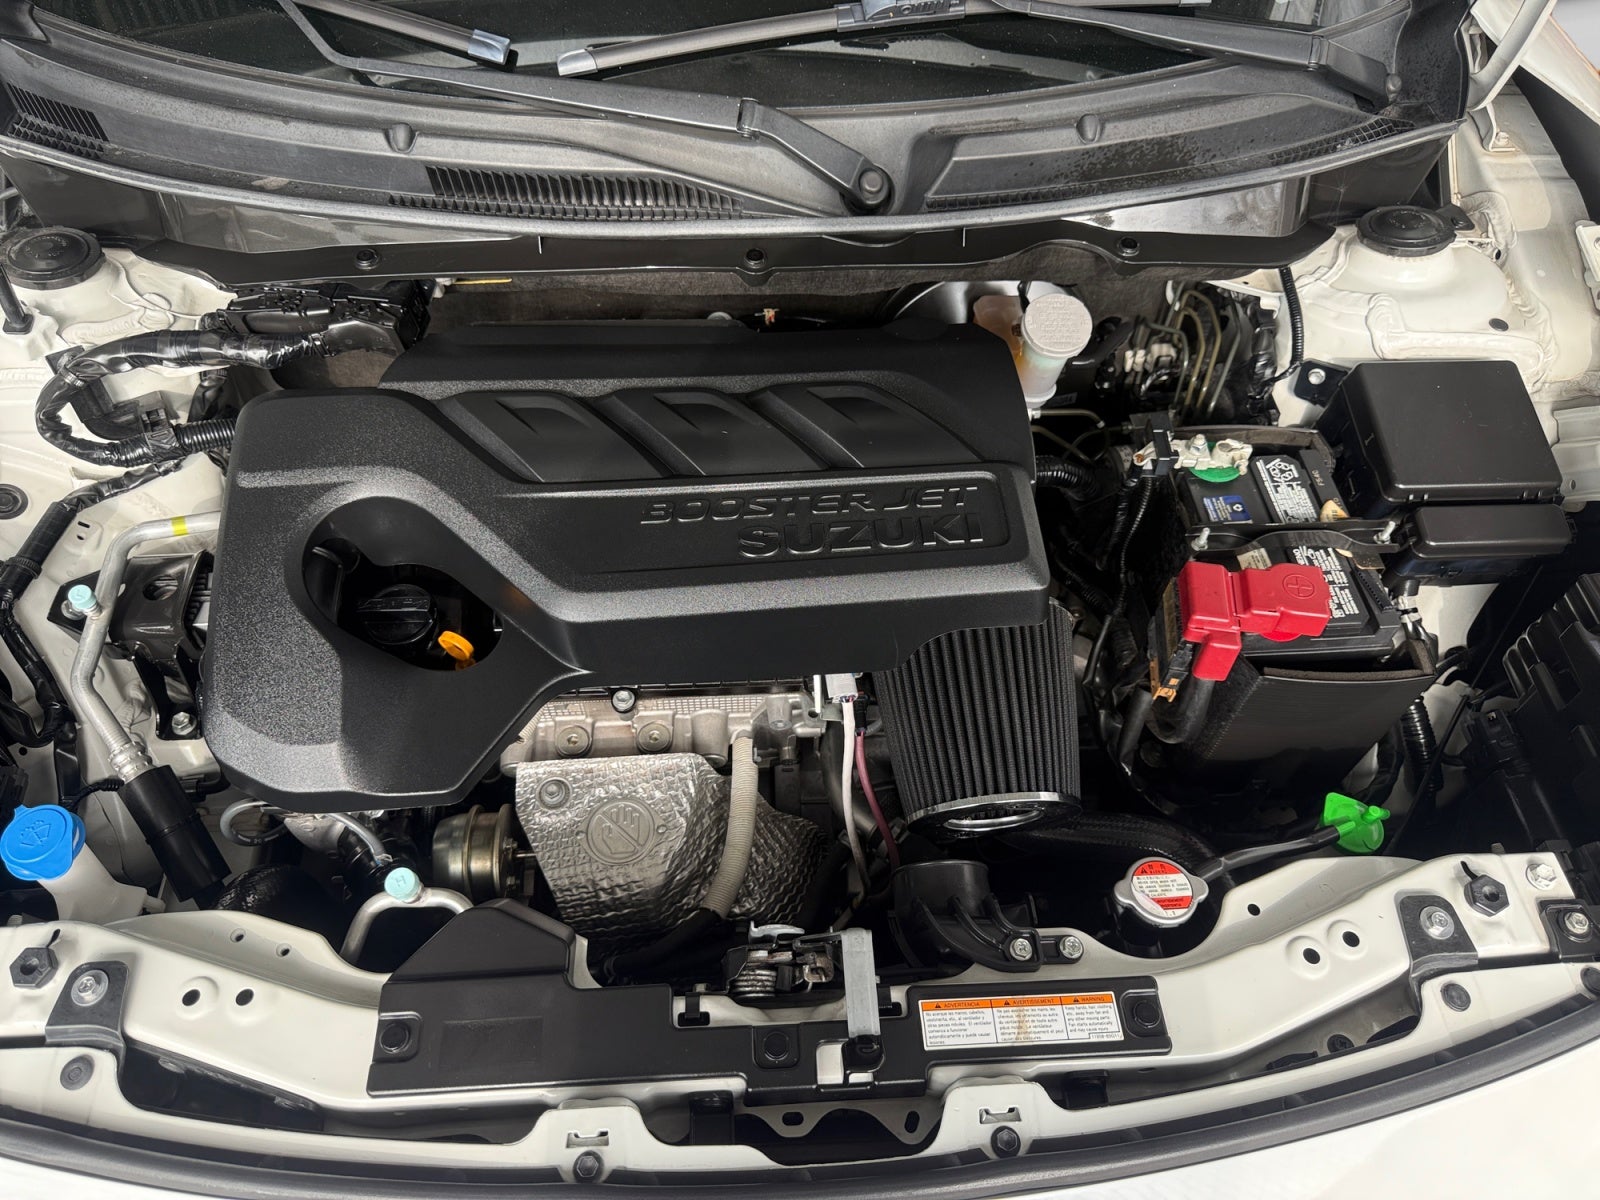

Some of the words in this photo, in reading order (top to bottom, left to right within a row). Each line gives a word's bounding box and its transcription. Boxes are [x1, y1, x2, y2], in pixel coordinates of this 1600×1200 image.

[639, 492, 876, 525] BOOSTER
[883, 485, 978, 511] JET
[738, 514, 984, 558] SUZUKI
